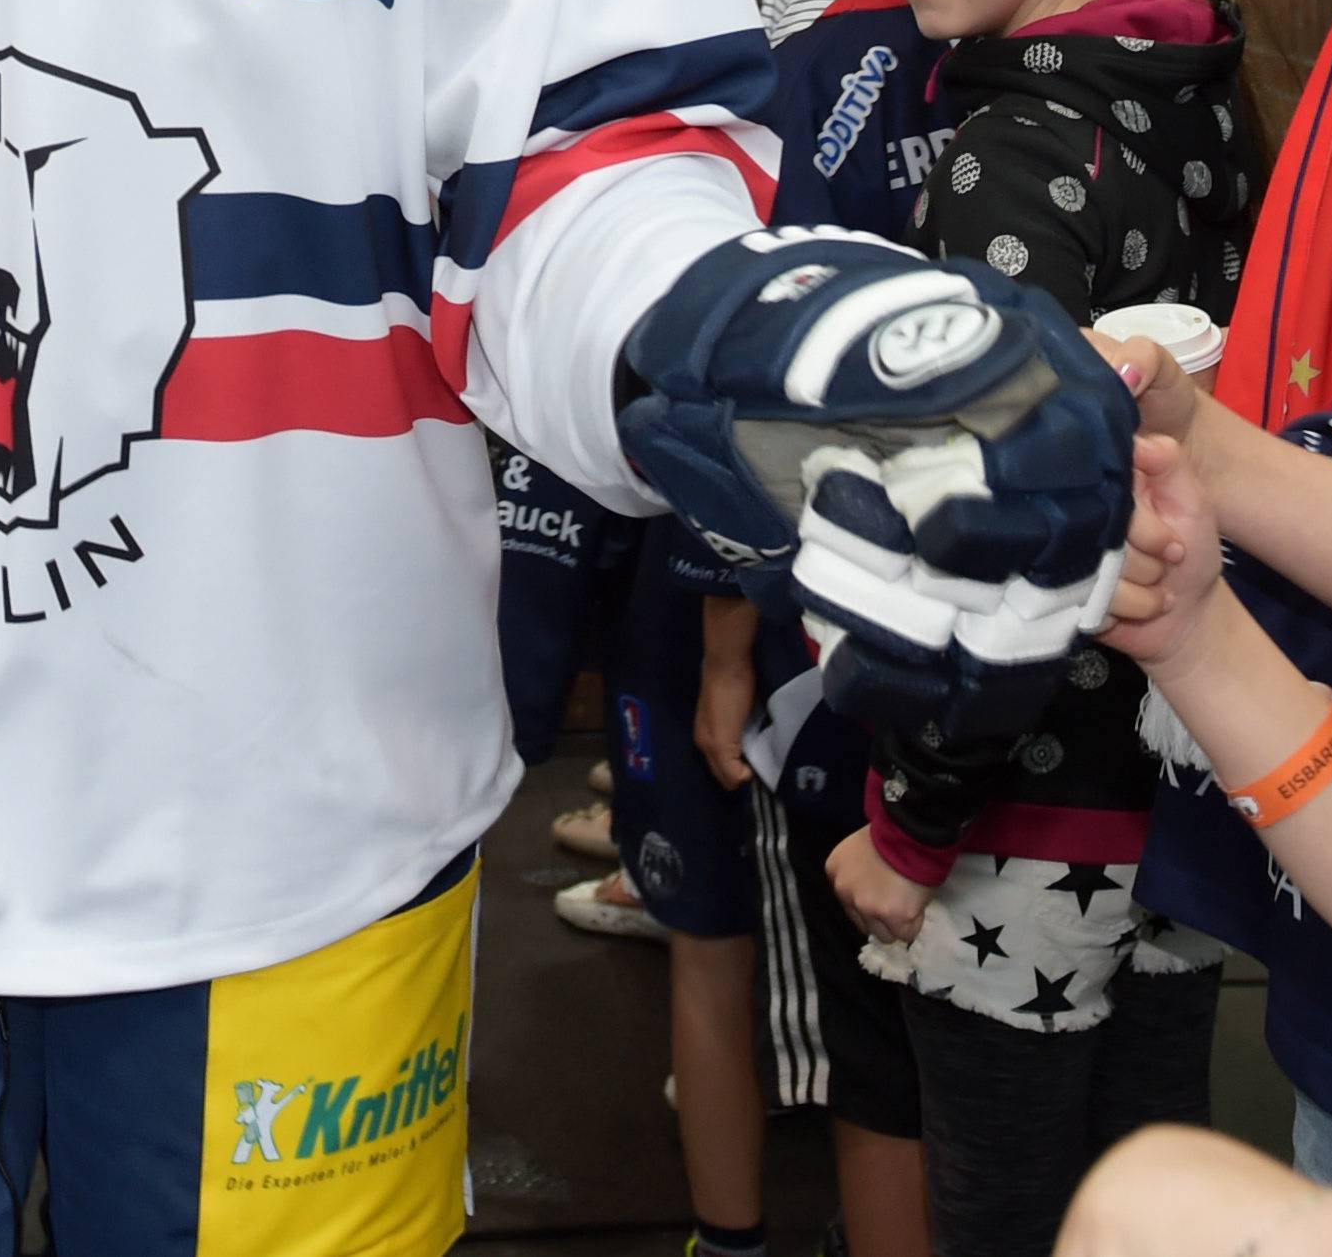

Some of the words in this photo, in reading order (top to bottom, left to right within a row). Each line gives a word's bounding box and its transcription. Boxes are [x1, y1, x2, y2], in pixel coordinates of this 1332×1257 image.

[503, 455, 532, 492] &
[496, 500, 584, 548] auck
[295, 1011, 465, 1161] Knittel
